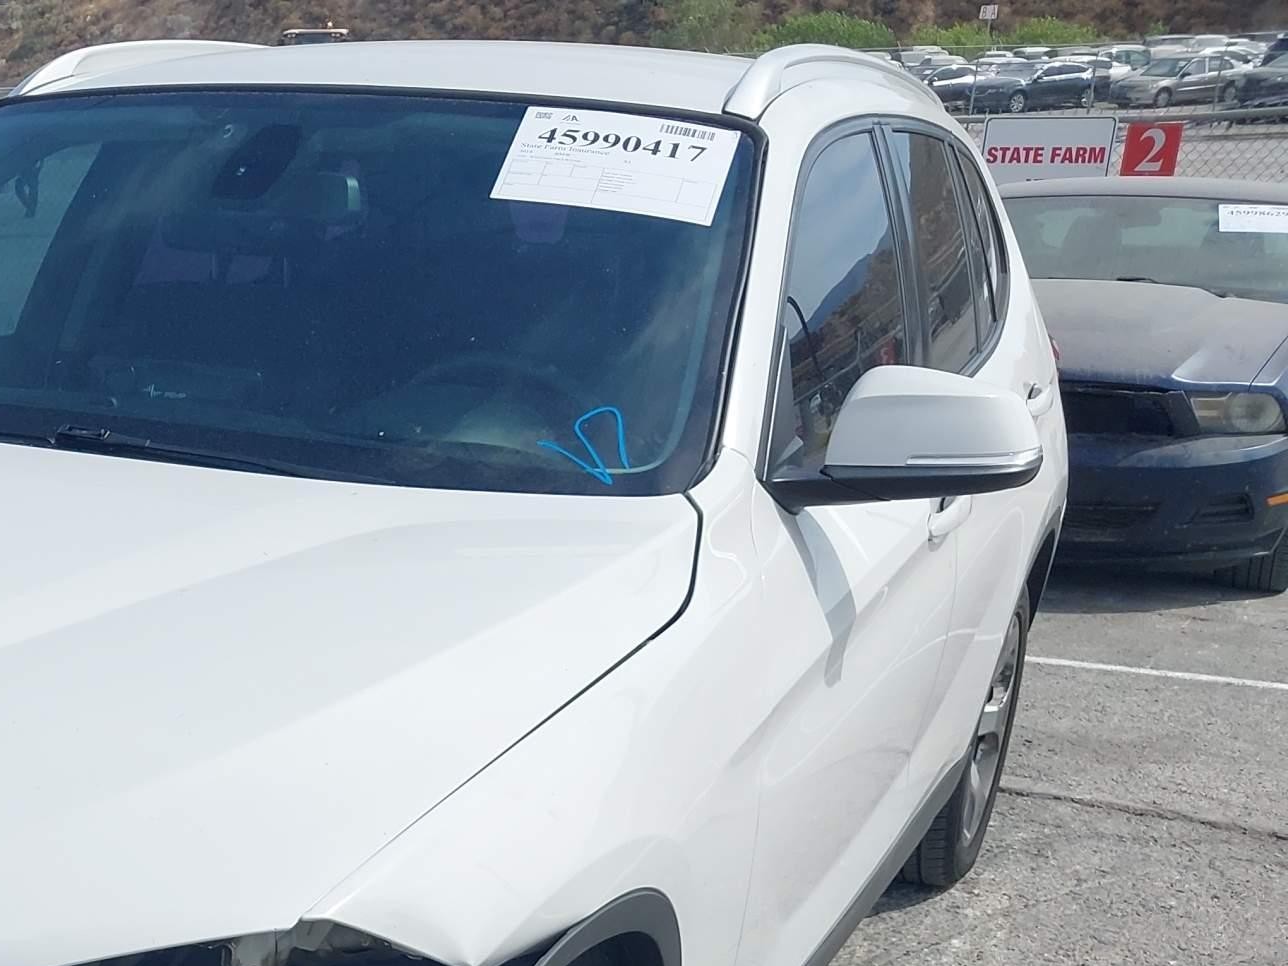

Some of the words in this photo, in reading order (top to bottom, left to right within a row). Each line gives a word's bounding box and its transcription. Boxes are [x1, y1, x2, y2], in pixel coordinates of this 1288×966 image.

[538, 127, 708, 162] 45990417
[986, 146, 1044, 164] STATE
[1050, 146, 1106, 164] FARM
[1134, 128, 1166, 171] 2
